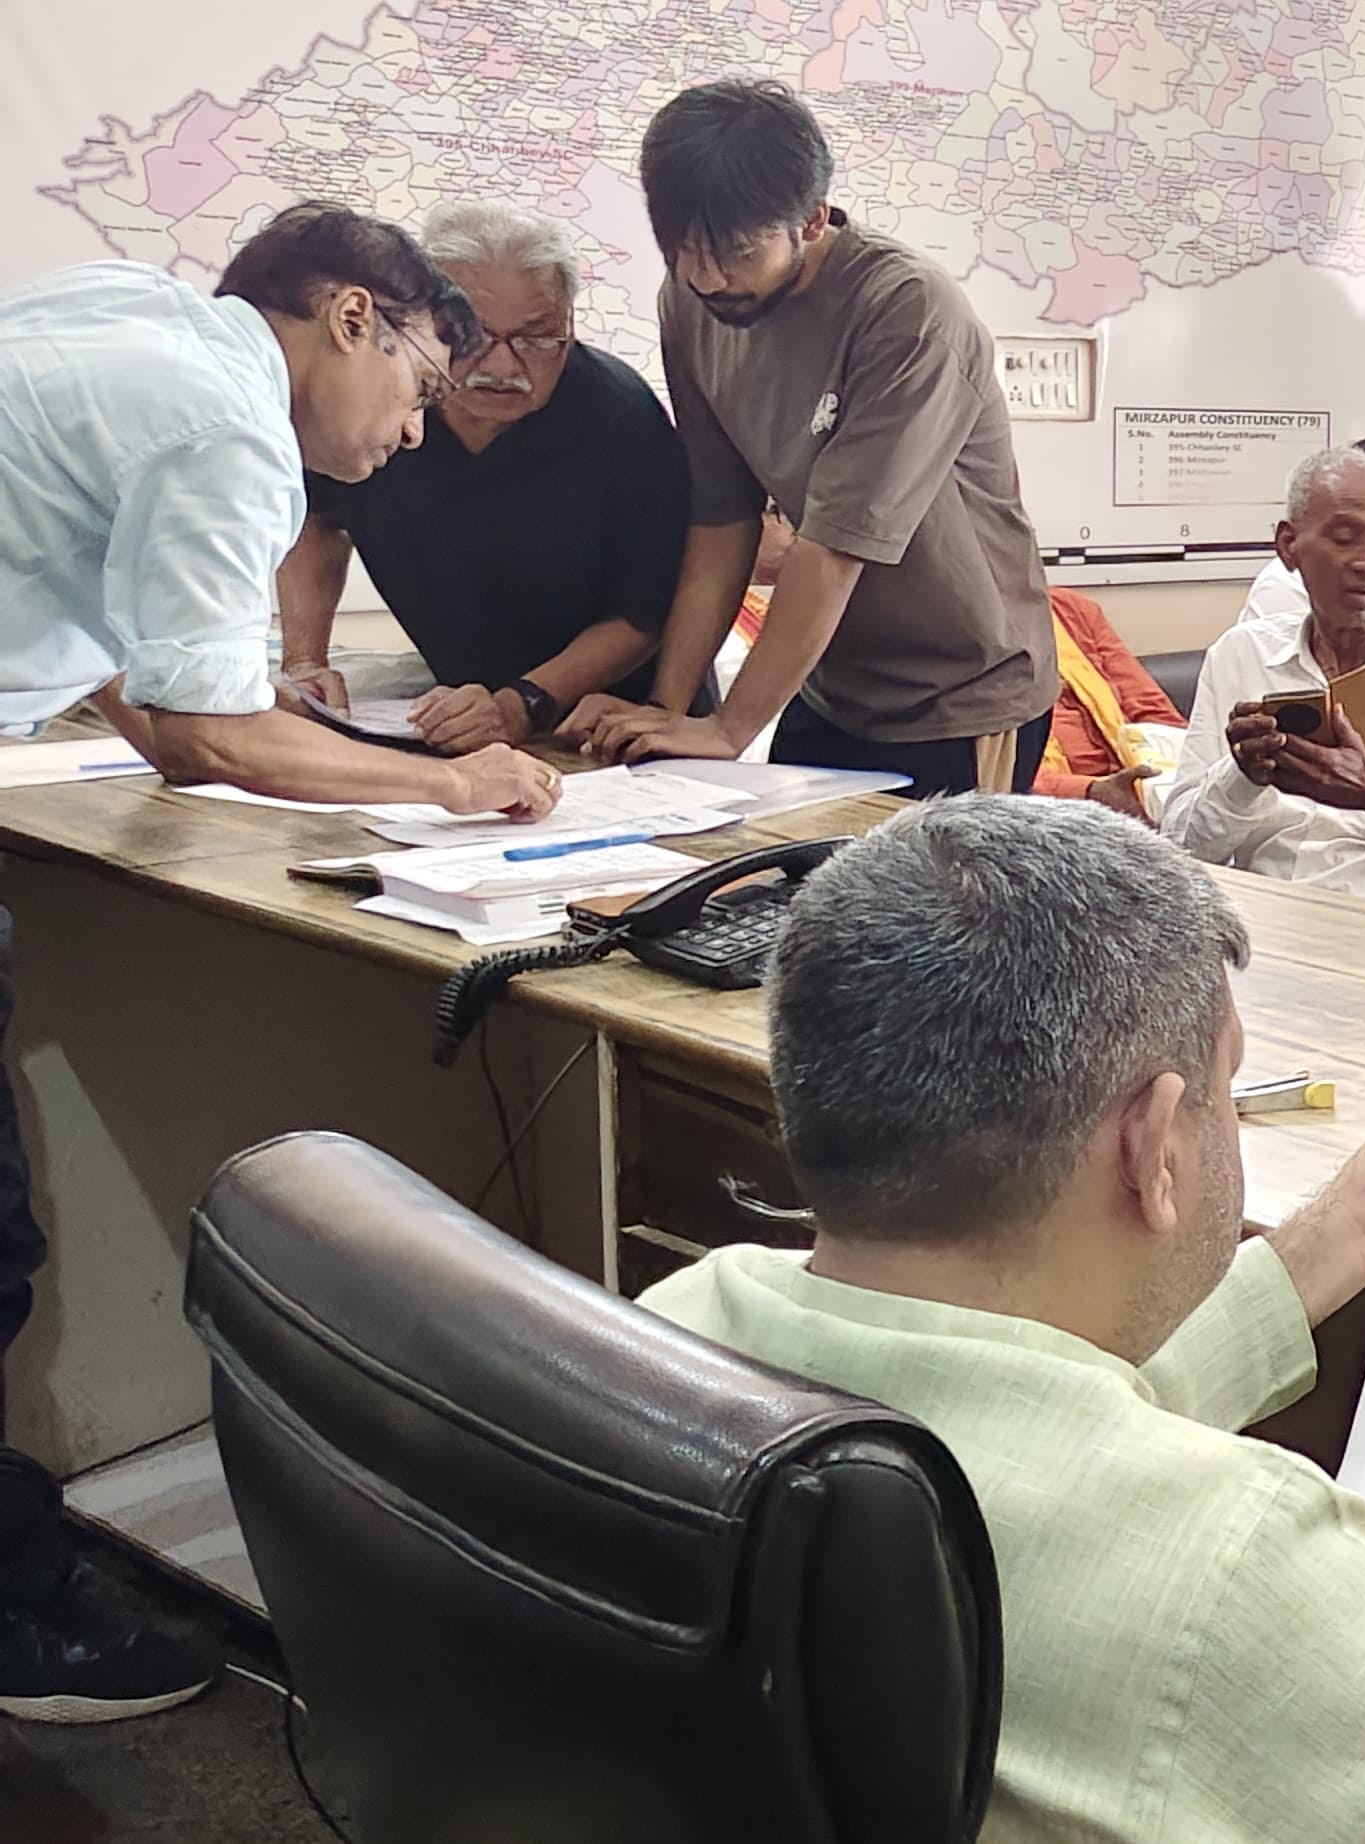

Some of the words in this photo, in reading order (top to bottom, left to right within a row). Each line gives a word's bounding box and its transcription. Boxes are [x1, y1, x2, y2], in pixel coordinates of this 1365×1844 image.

[1125, 412, 1197, 424] MIRZAPUR
[1200, 413, 1295, 426] CONSTITUENCY
[1297, 415, 1321, 428] (79)
[1168, 430, 1214, 440] Assembly
[1216, 431, 1277, 441] Constituency
[1180, 524, 1191, 537] 8
